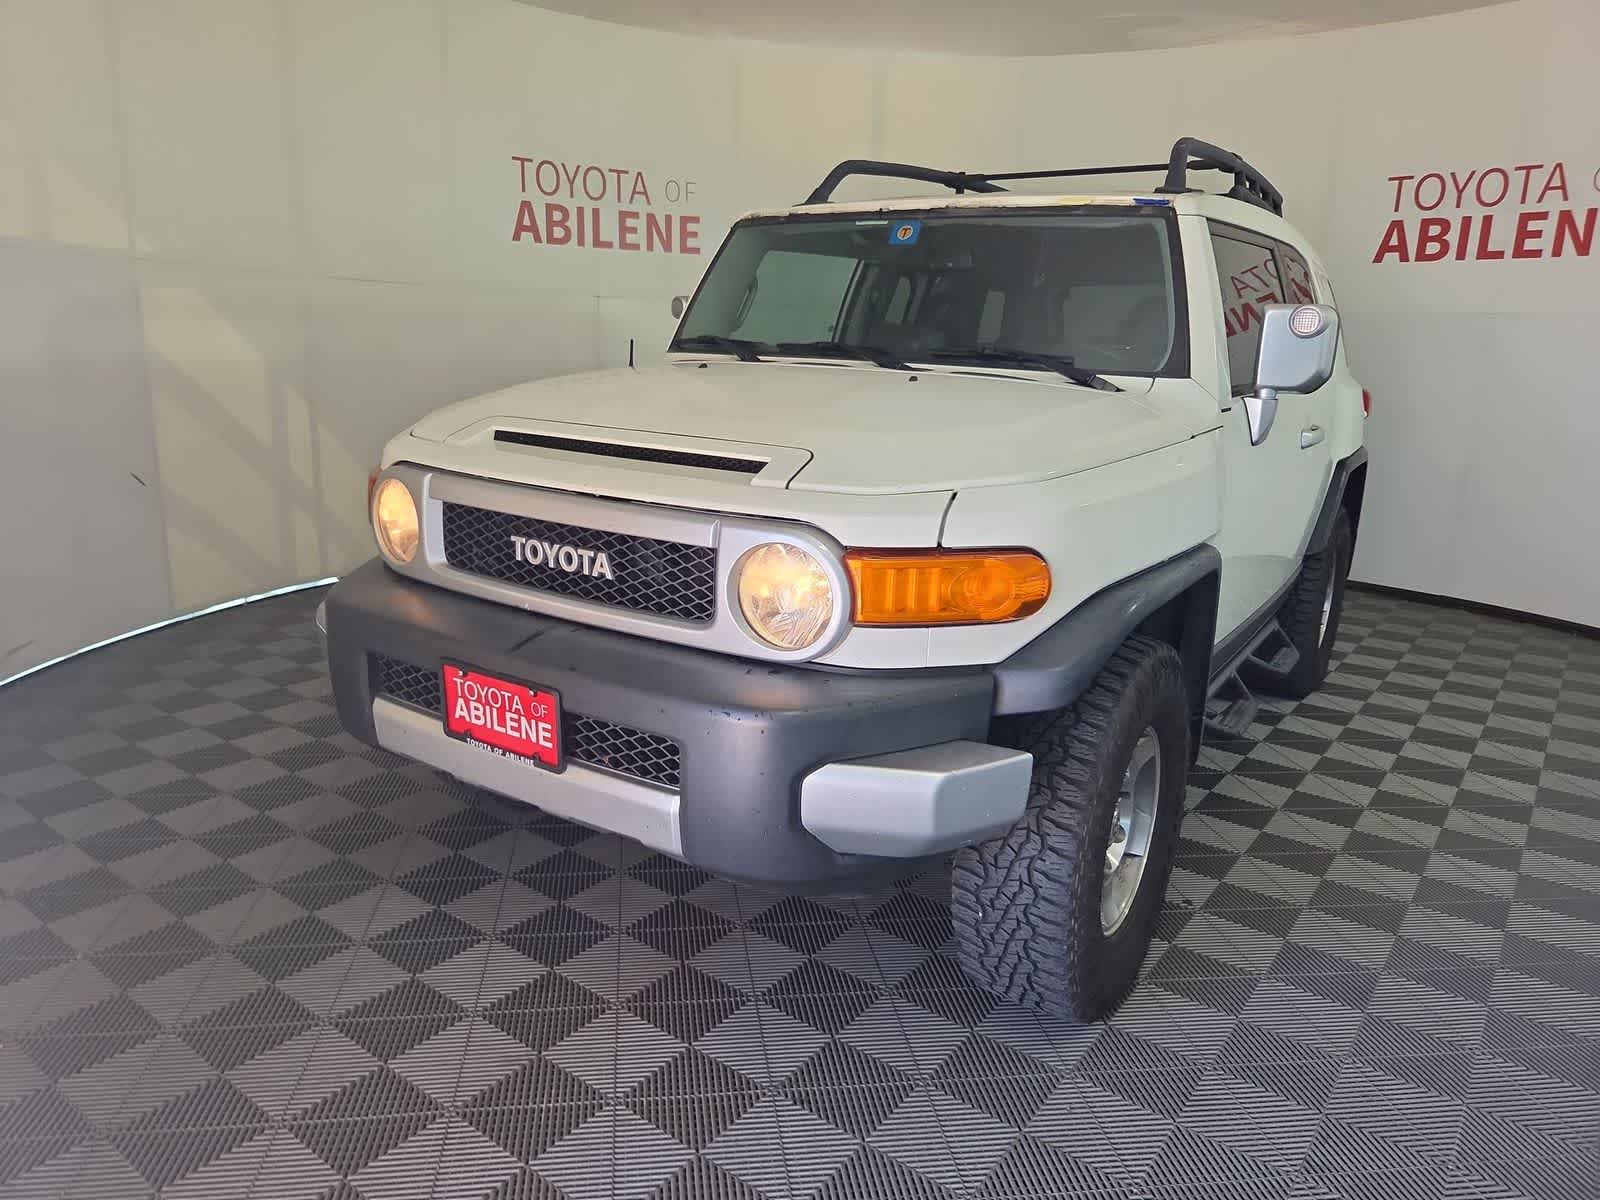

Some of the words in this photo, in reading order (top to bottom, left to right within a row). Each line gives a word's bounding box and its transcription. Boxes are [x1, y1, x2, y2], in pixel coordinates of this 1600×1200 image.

[511, 156, 651, 205] TOYOTA
[664, 179, 697, 203] OF
[1387, 162, 1569, 213] TOYOTA
[511, 200, 701, 255] ABILENE
[1371, 207, 1599, 264] ABILEN
[510, 535, 614, 580] TOYOTA
[453, 677, 525, 715] TOYOTA
[530, 702, 549, 718] OF
[454, 698, 553, 749] ABILENE
